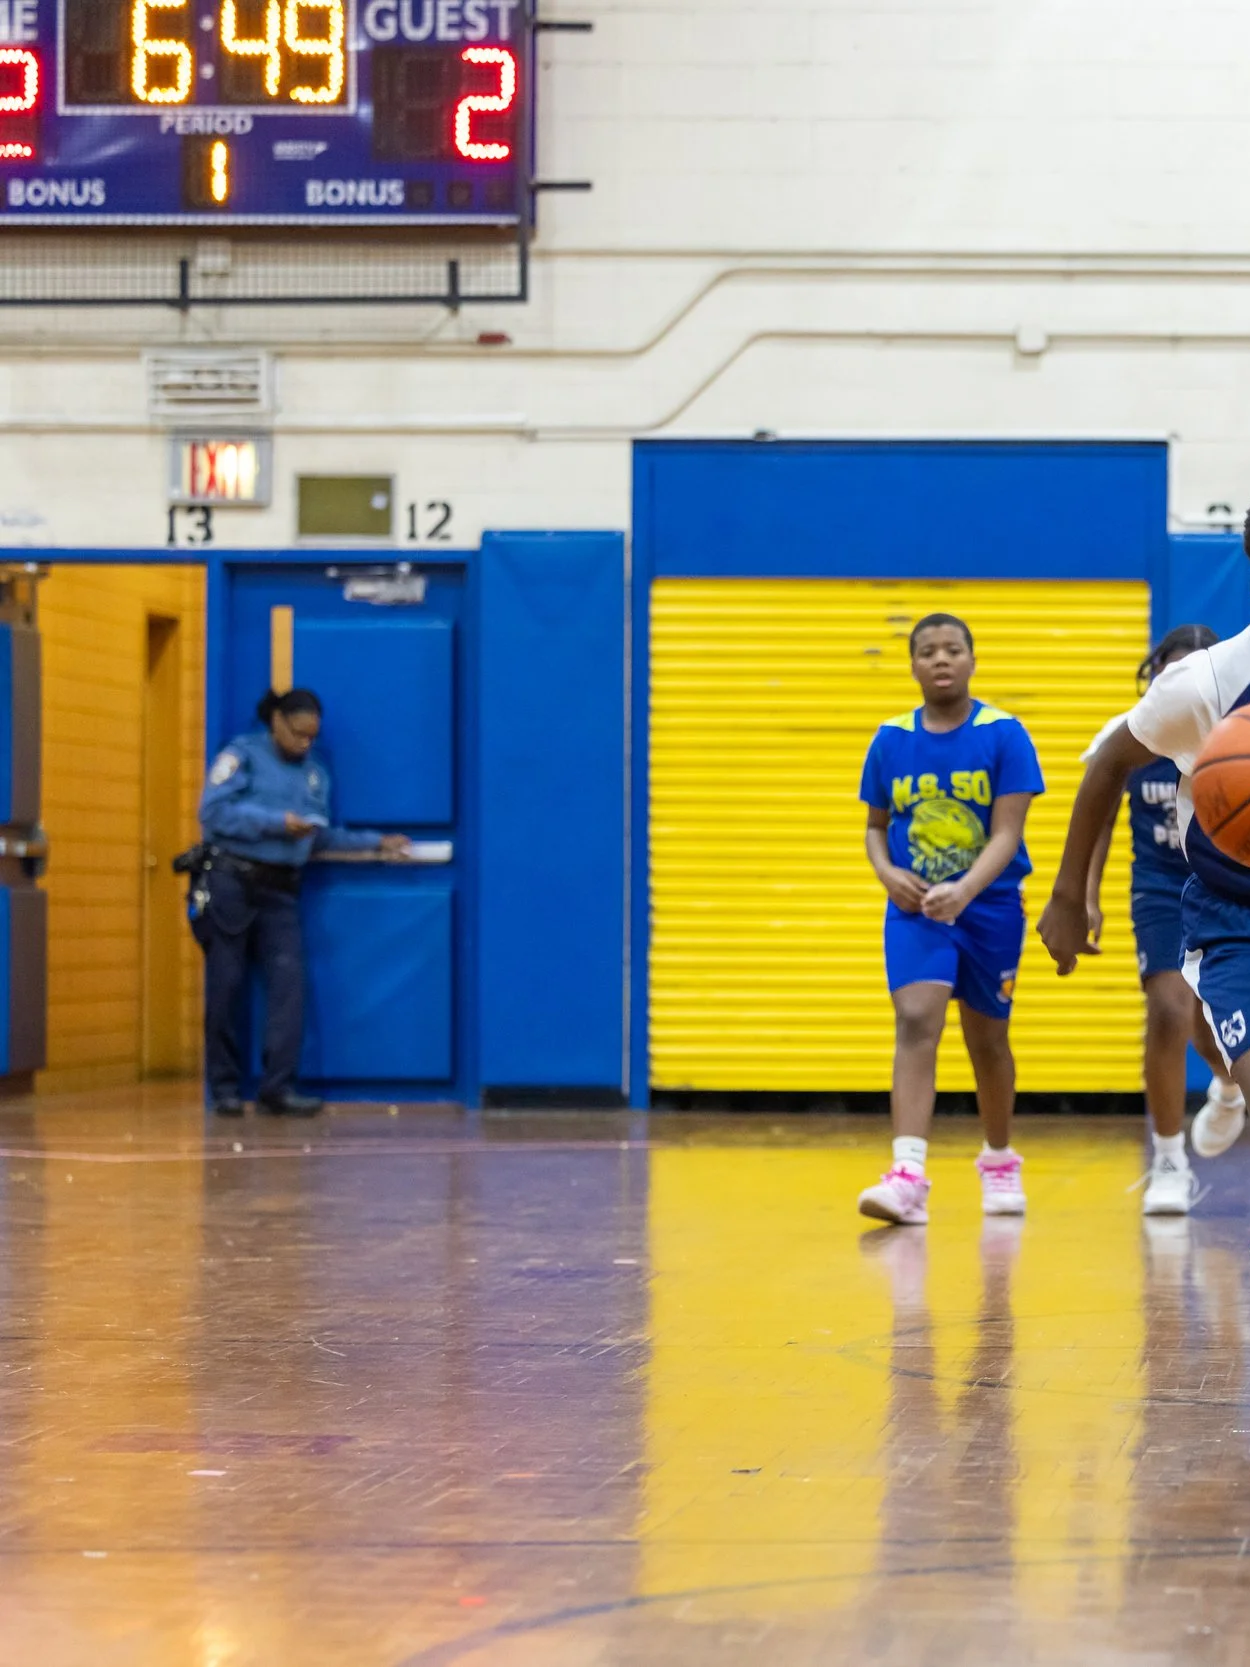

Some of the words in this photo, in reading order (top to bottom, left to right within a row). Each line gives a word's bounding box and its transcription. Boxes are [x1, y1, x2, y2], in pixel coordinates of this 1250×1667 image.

[363, 0, 518, 42] GUEST
[455, 47, 515, 159] 2
[160, 115, 254, 135] PERIOD
[211, 140, 228, 202] 1
[8, 178, 106, 207] BONUS
[305, 178, 405, 207] BONUS
[167, 503, 214, 544] 13
[407, 501, 454, 540] 12
[891, 773, 947, 813] M.S.
[950, 769, 992, 807] 50
